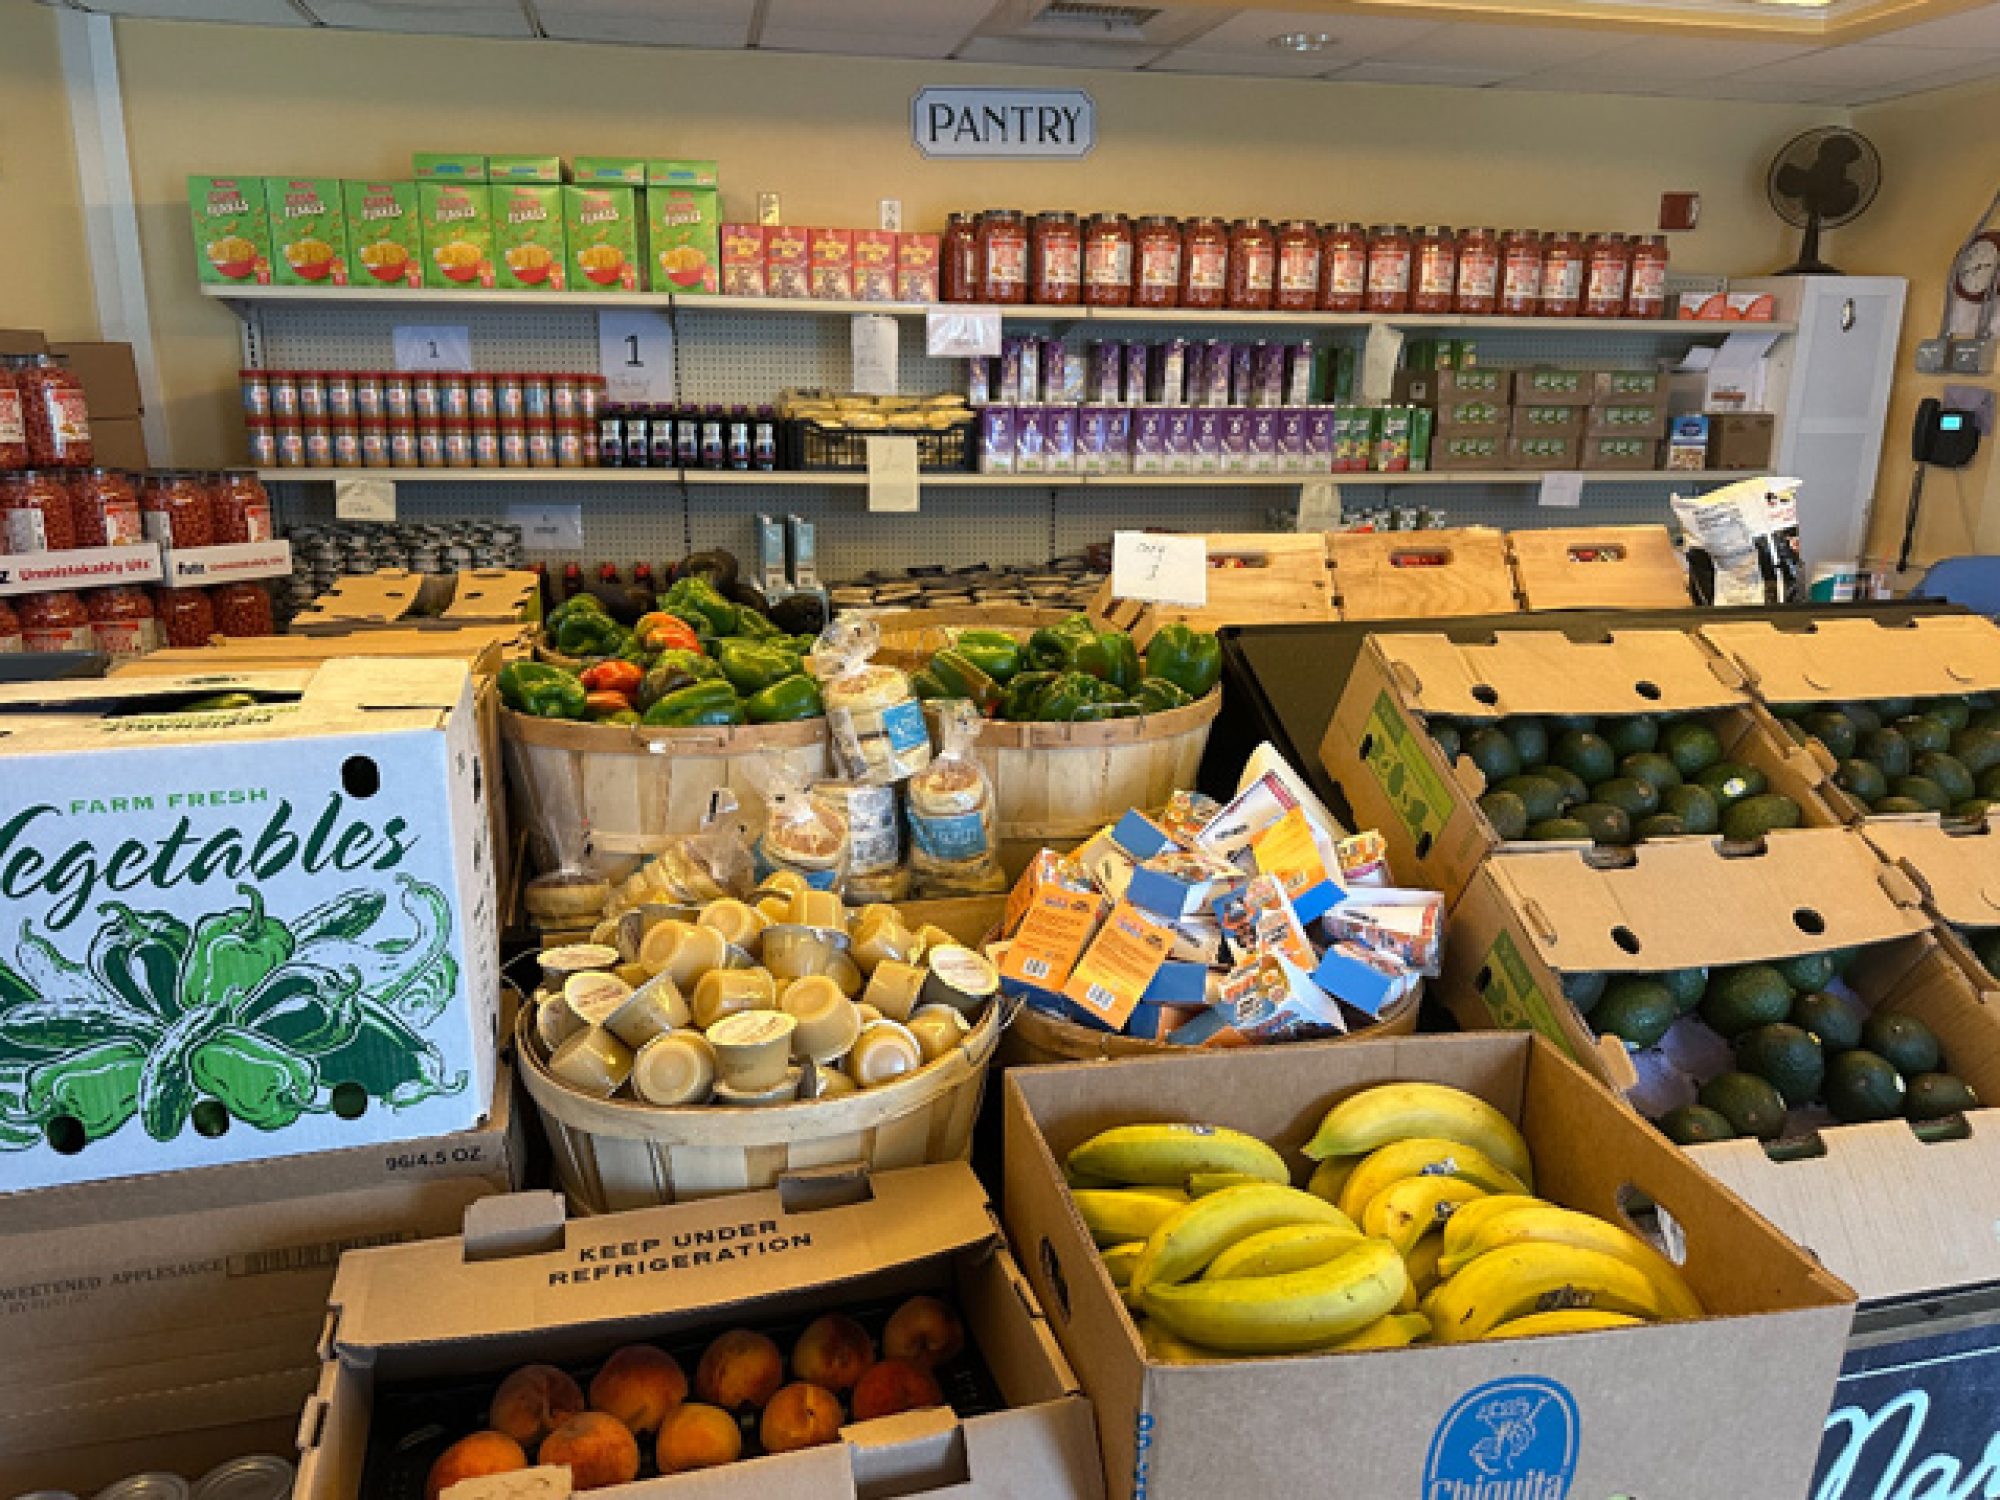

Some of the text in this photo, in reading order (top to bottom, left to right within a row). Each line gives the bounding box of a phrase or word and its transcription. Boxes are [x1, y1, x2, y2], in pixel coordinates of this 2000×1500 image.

[928, 103, 1083, 144] PANTRY
[427, 338, 440, 358] 1
[624, 333, 645, 368] 1
[19, 561, 123, 581] Unmistakably
[70, 788, 268, 816] FARM FRESH
[579, 1220, 777, 1262] KEEP UNDER
[548, 1232, 812, 1287] REFRIGERATION
